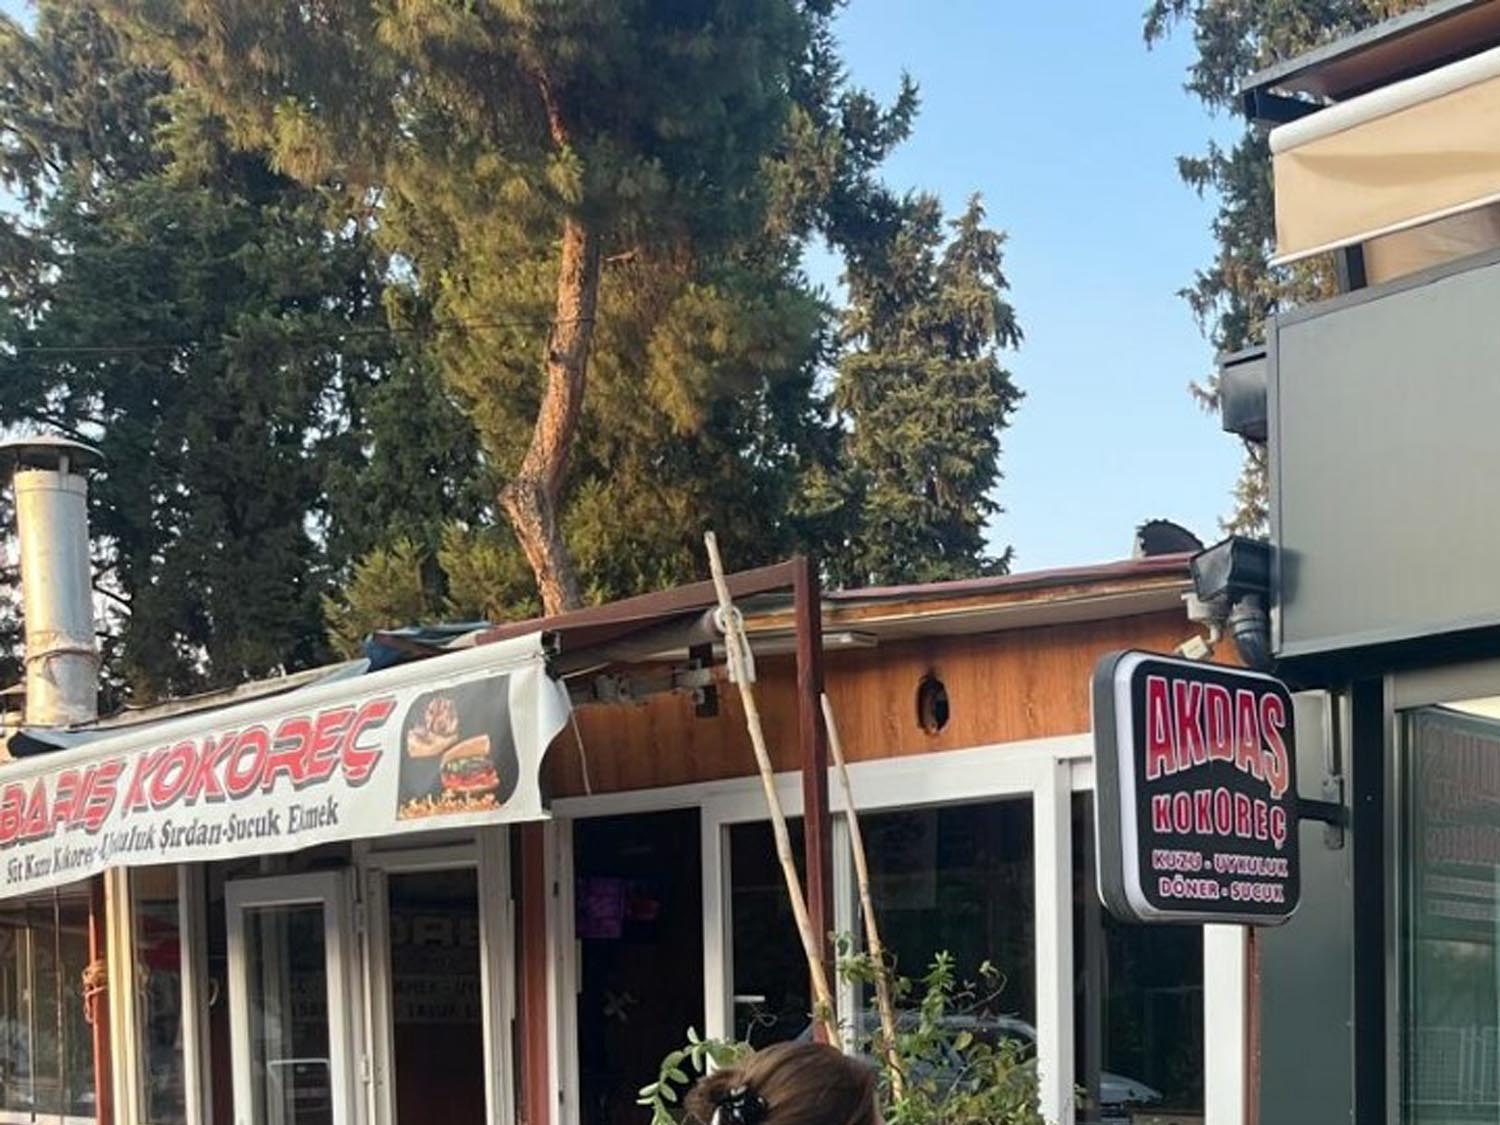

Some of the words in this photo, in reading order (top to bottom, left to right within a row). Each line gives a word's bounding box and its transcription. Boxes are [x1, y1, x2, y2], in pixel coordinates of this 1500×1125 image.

[121, 696, 397, 818] KOKOREÇ
[1145, 674, 1289, 800] AKDAŞ
[1152, 786, 1287, 850] KOKOREÇ
[1152, 850, 1203, 871] KUZU
[1213, 853, 1288, 877] UYKULUK
[1159, 874, 1220, 899] DÖNER
[1230, 881, 1284, 903] SUCUK
